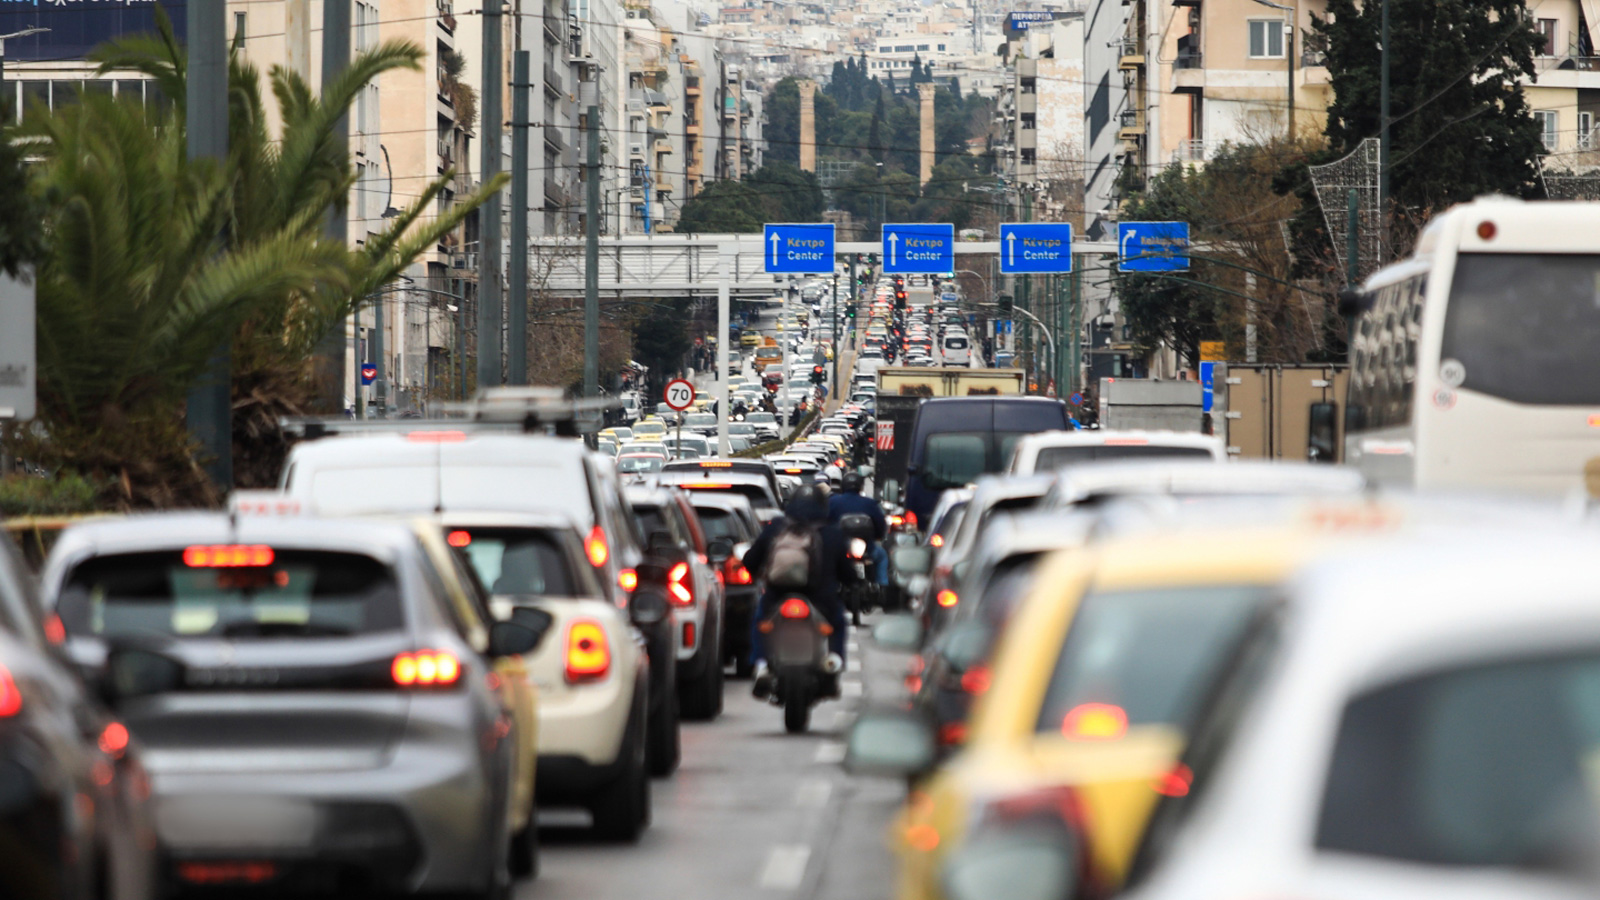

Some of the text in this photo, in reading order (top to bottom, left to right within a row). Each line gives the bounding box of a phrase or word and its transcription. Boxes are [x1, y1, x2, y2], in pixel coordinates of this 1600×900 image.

[787, 238, 825, 249] Κέντρο
[905, 238, 943, 249] Κέντρο
[1023, 237, 1061, 249] Κέντρο
[787, 250, 824, 260] Center
[905, 250, 942, 260] Center
[1023, 250, 1060, 260] Center
[671, 388, 689, 401] 70
